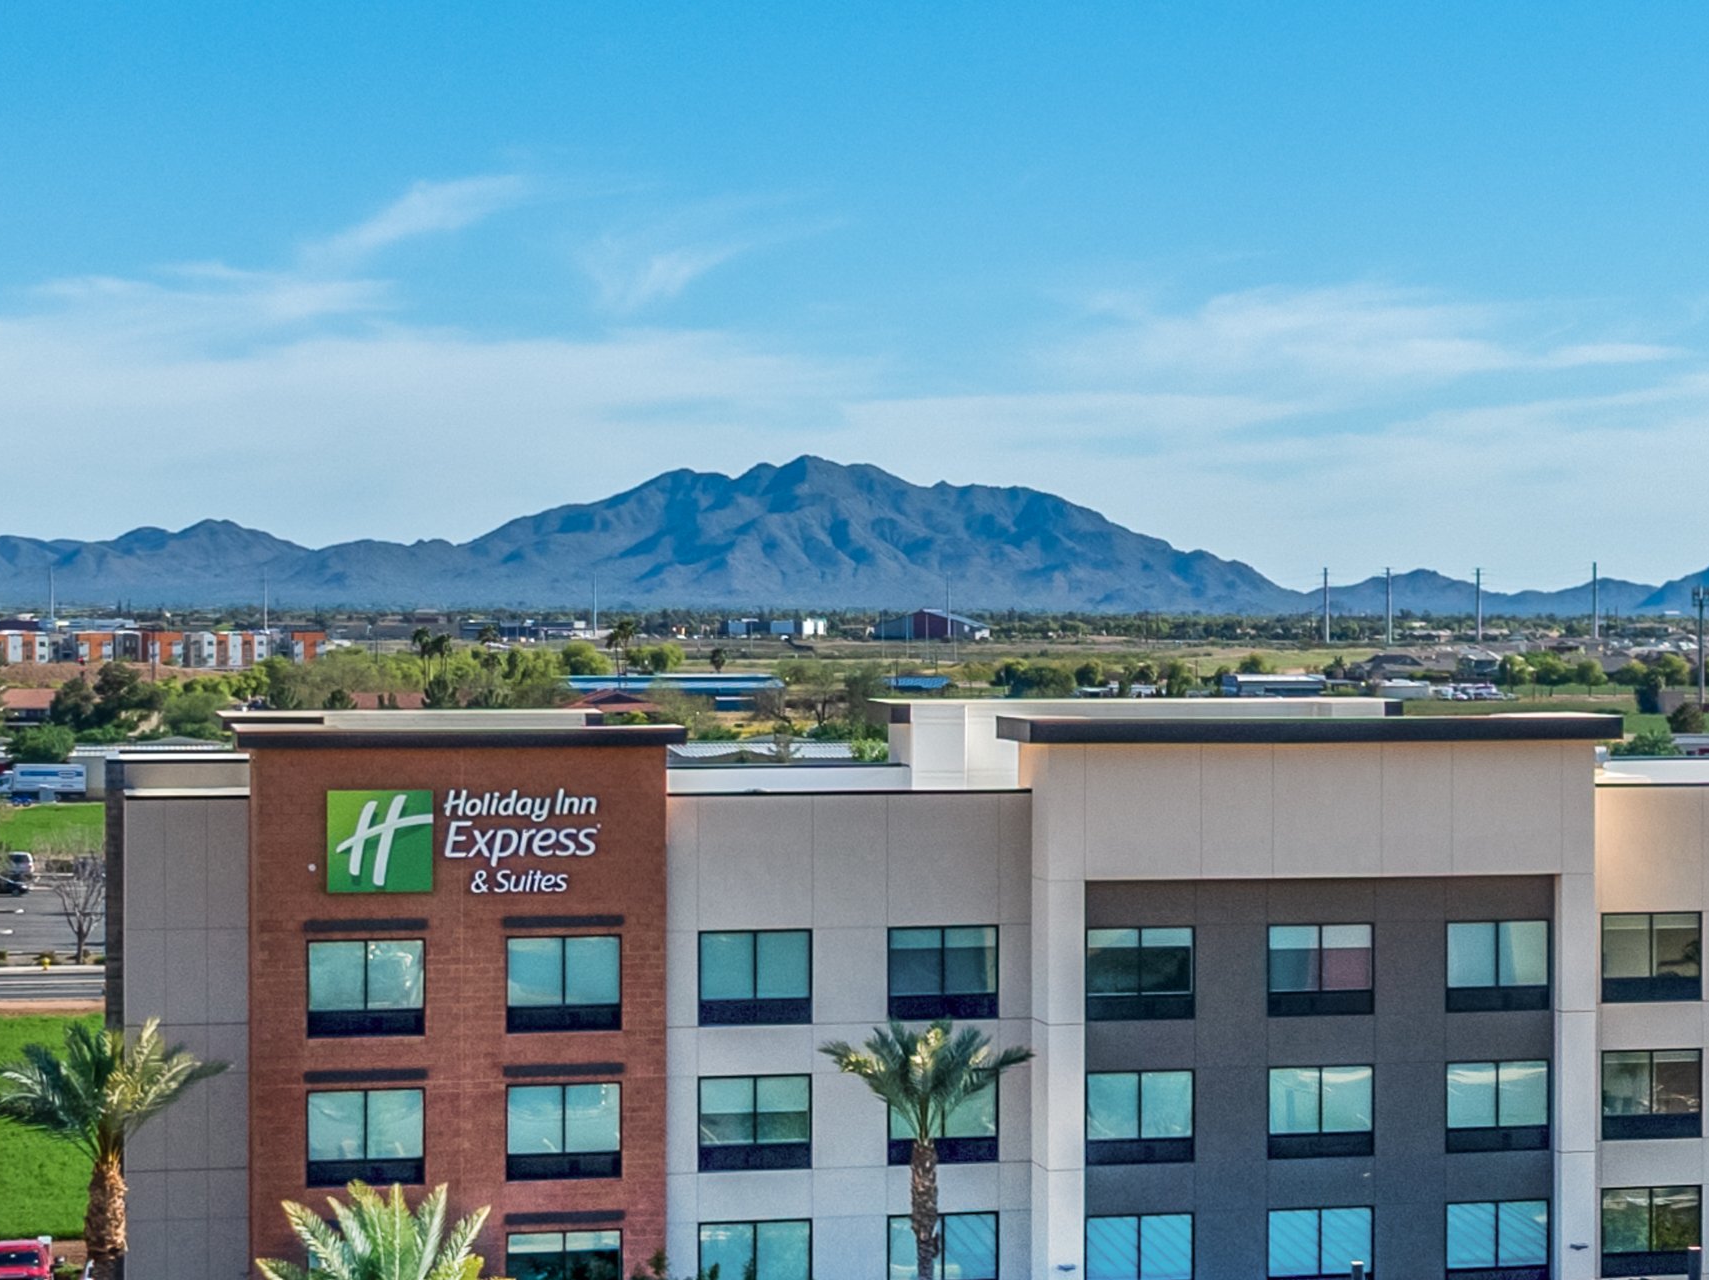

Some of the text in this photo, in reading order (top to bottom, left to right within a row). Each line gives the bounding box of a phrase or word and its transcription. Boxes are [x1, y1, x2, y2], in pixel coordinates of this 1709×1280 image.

[444, 788, 597, 822] Holiday Inn
[444, 821, 598, 867] Express
[471, 870, 568, 893] & Suites
